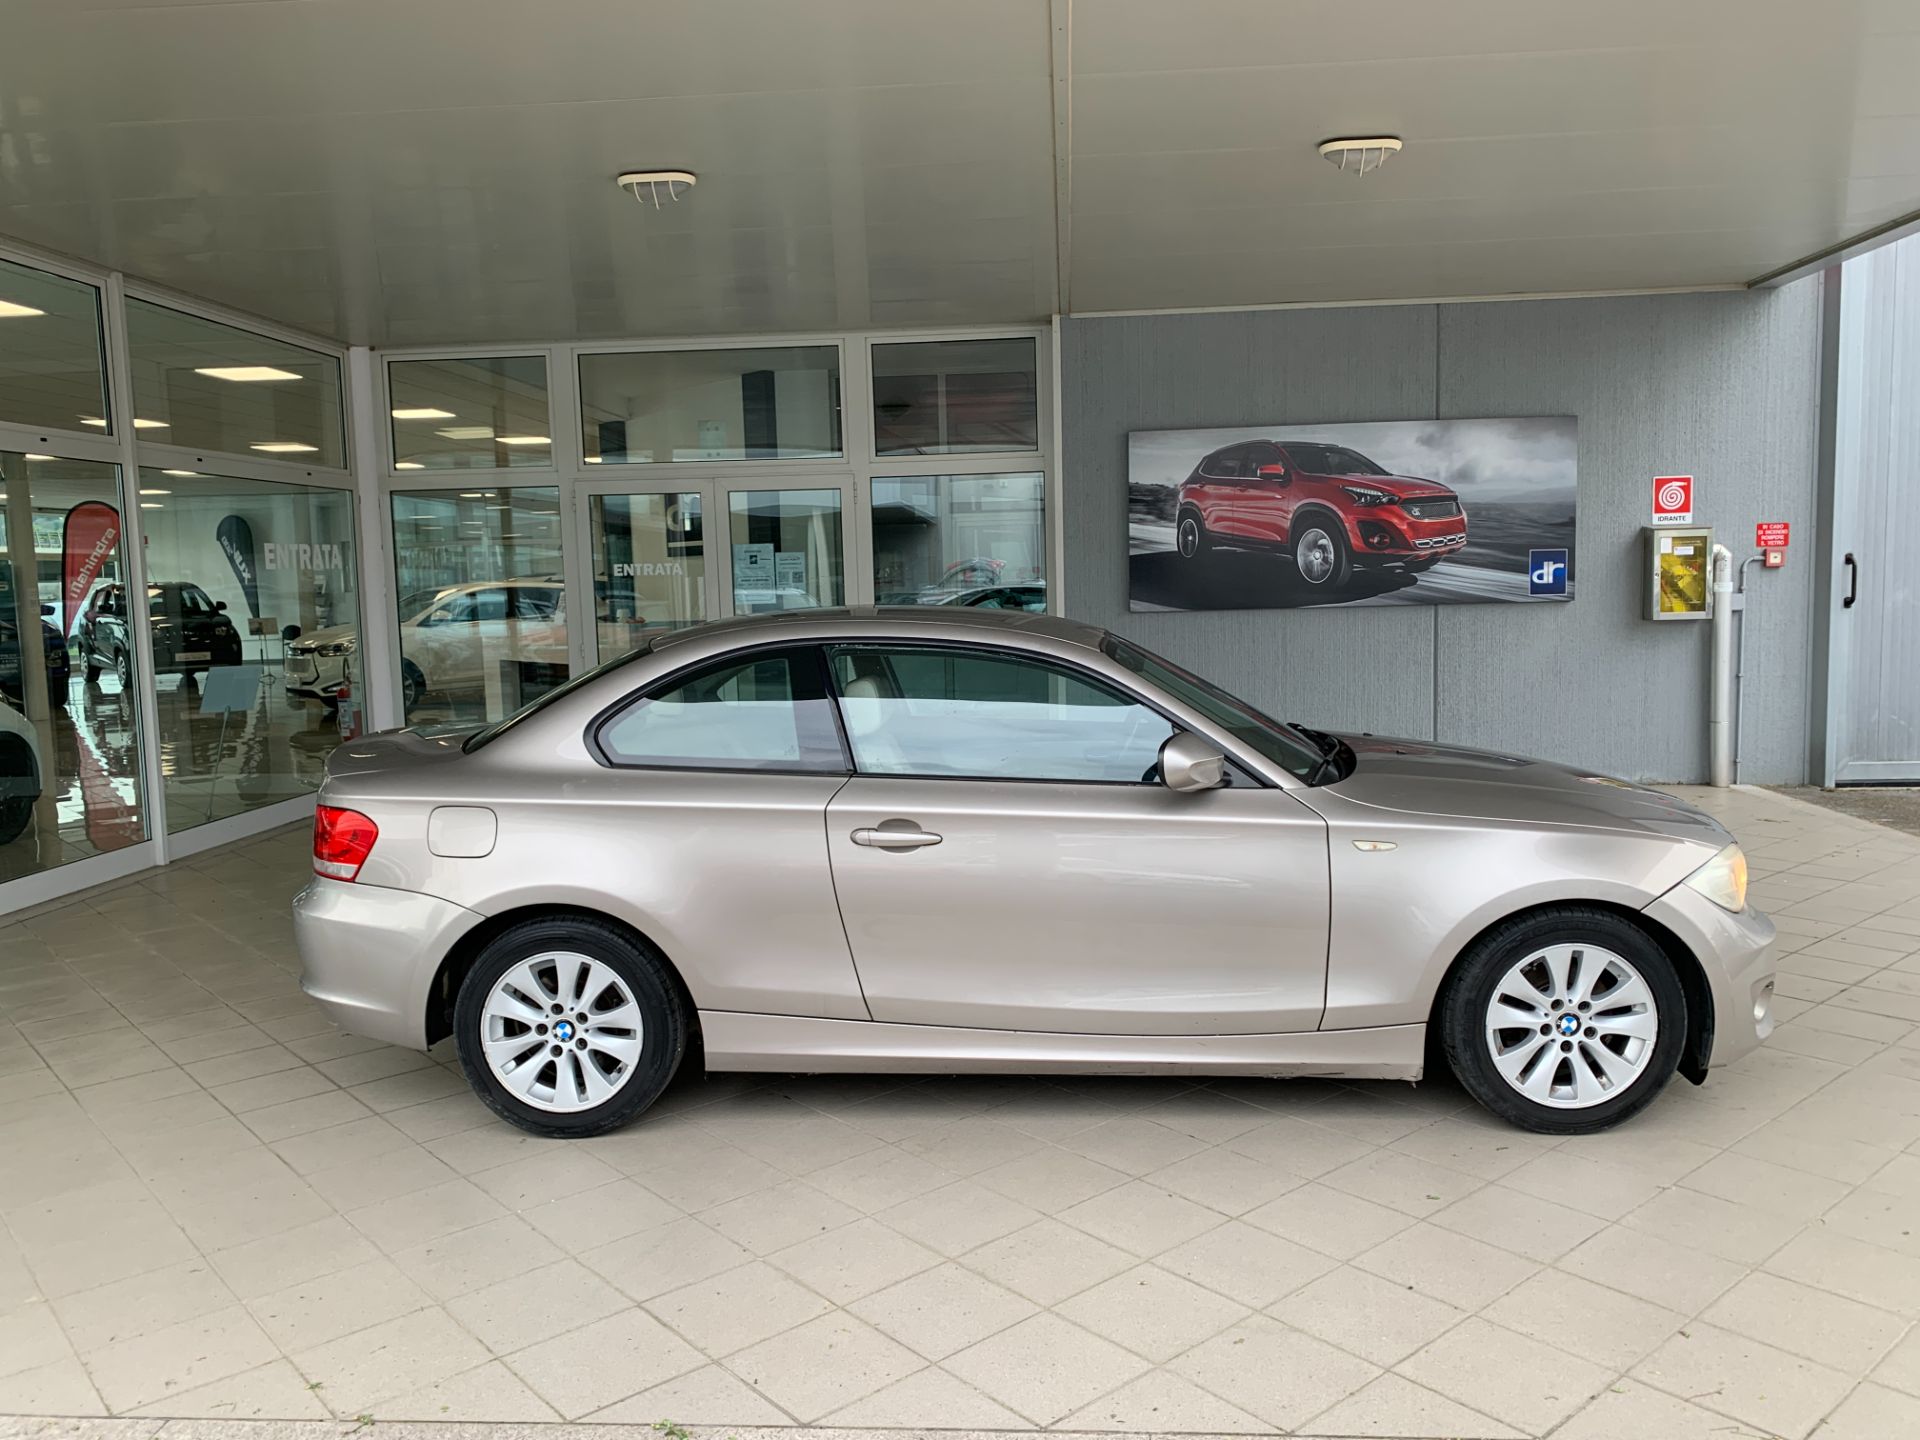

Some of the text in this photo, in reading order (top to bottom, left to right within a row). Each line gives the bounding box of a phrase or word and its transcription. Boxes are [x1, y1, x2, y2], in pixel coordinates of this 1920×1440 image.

[264, 542, 342, 571] ENTRATA
[613, 563, 683, 577] ENTRATA
[1532, 561, 1565, 584] dr
